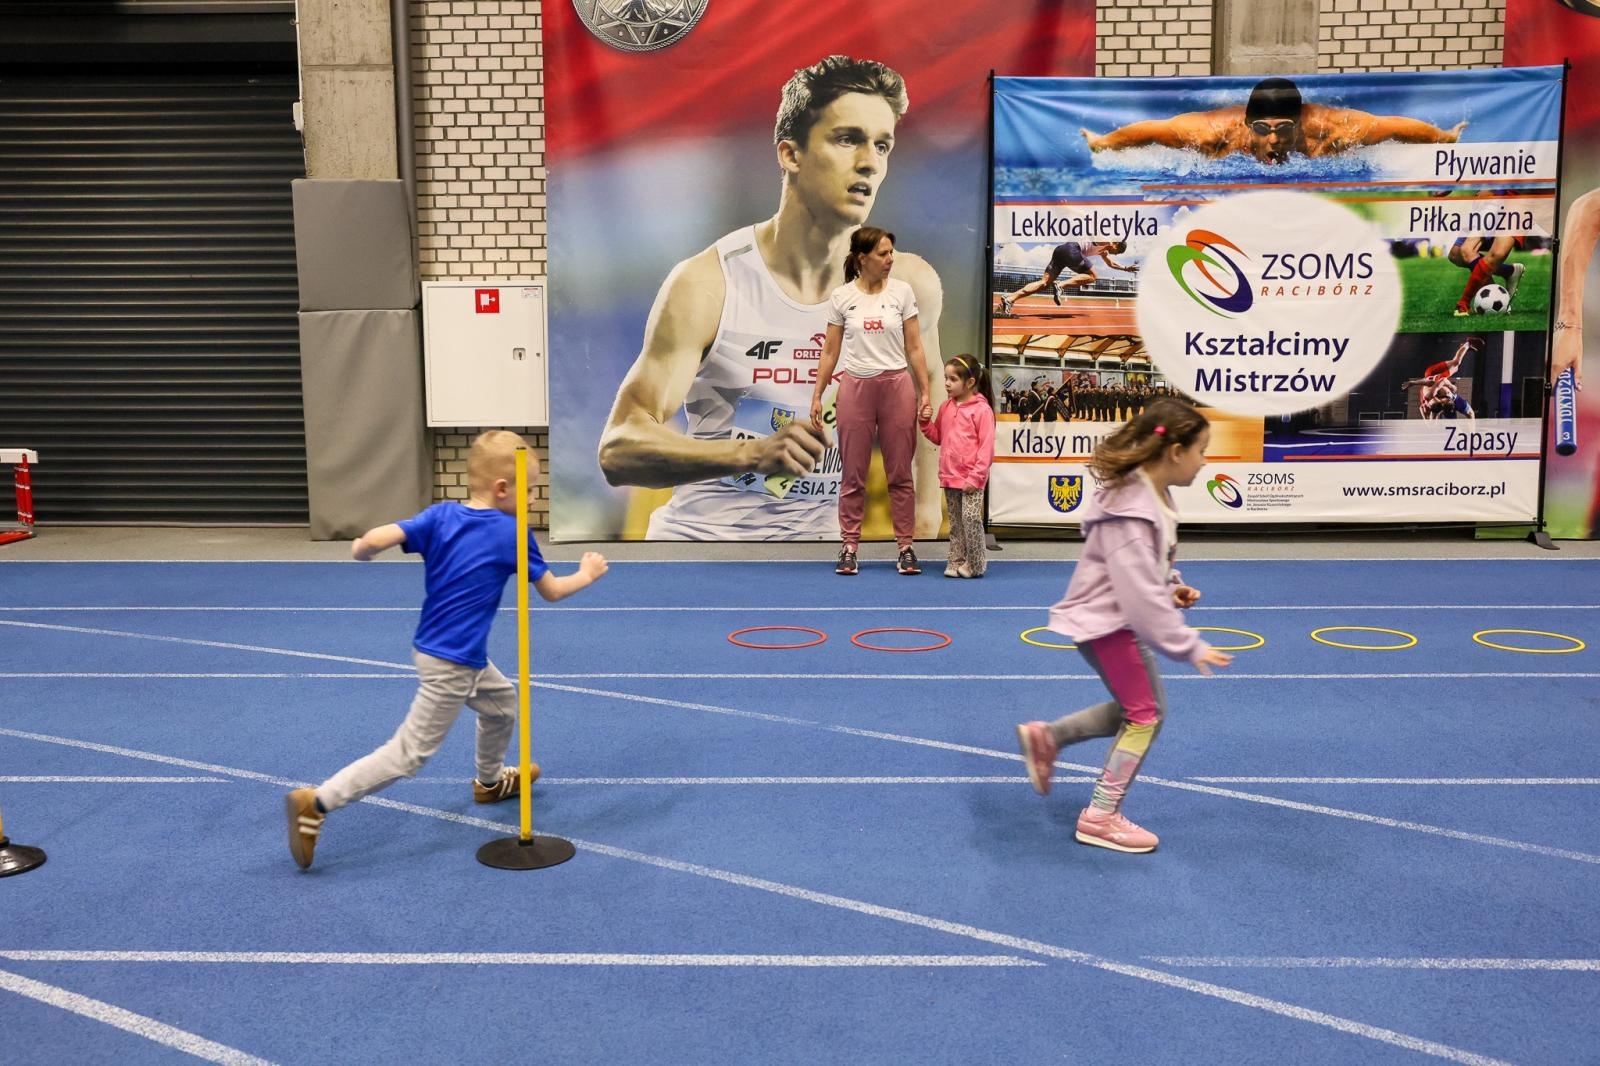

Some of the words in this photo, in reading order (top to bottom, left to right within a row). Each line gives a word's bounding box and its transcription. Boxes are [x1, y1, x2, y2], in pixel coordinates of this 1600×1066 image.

[1435, 149, 1536, 182] Pływanie
[1011, 210, 1158, 243] Lekkoatletyka
[1409, 205, 1461, 232] Piłka
[1468, 205, 1533, 231] nożna
[1260, 252, 1374, 280] ZSOMS
[1260, 283, 1374, 297] RACIBÓRZ
[745, 340, 783, 360] 4F
[795, 350, 821, 359] ORLE
[1185, 330, 1350, 363] Kształcimy
[752, 367, 845, 386] POLSK
[1194, 367, 1336, 392] Mistrzów
[1011, 428, 1066, 460] Klasy
[1443, 426, 1518, 457] Zapasy
[789, 480, 825, 496] ESIA
[1247, 472, 1295, 485] ZSOMS
[1342, 481, 1506, 499] www.smsraciborz.pl
